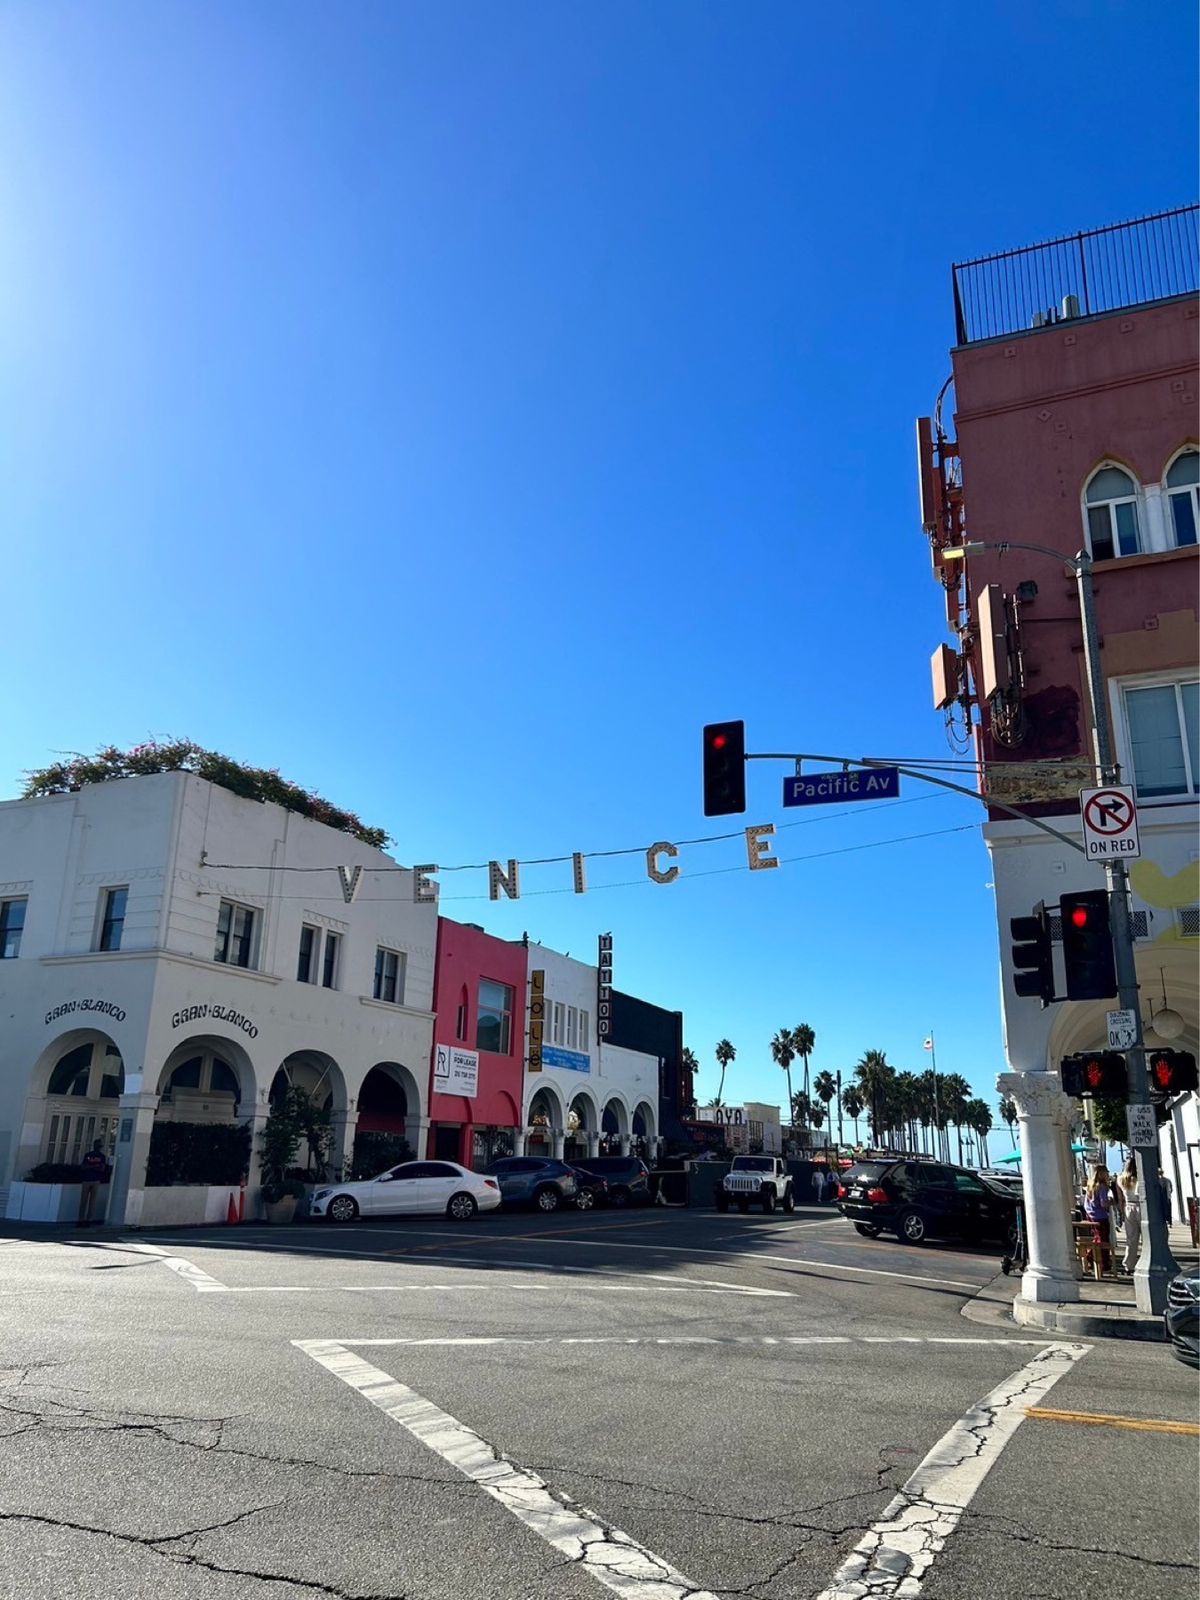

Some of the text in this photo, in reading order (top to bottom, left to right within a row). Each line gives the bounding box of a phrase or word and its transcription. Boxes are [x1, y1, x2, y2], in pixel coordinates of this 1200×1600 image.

[793, 778, 860, 798] Pacific
[866, 775, 890, 792] Av
[1090, 838, 1136, 854] ON RED
[338, 823, 780, 904] VENICE
[599, 935, 610, 1034] TATTOO
[44, 998, 127, 1025] GRAN BLANCO
[171, 1004, 259, 1039] GRAN BLANCO
[1109, 1030, 1121, 1046] OK
[453, 1056, 477, 1067] FOR LEASE
[1132, 1120, 1152, 1129] WALK
